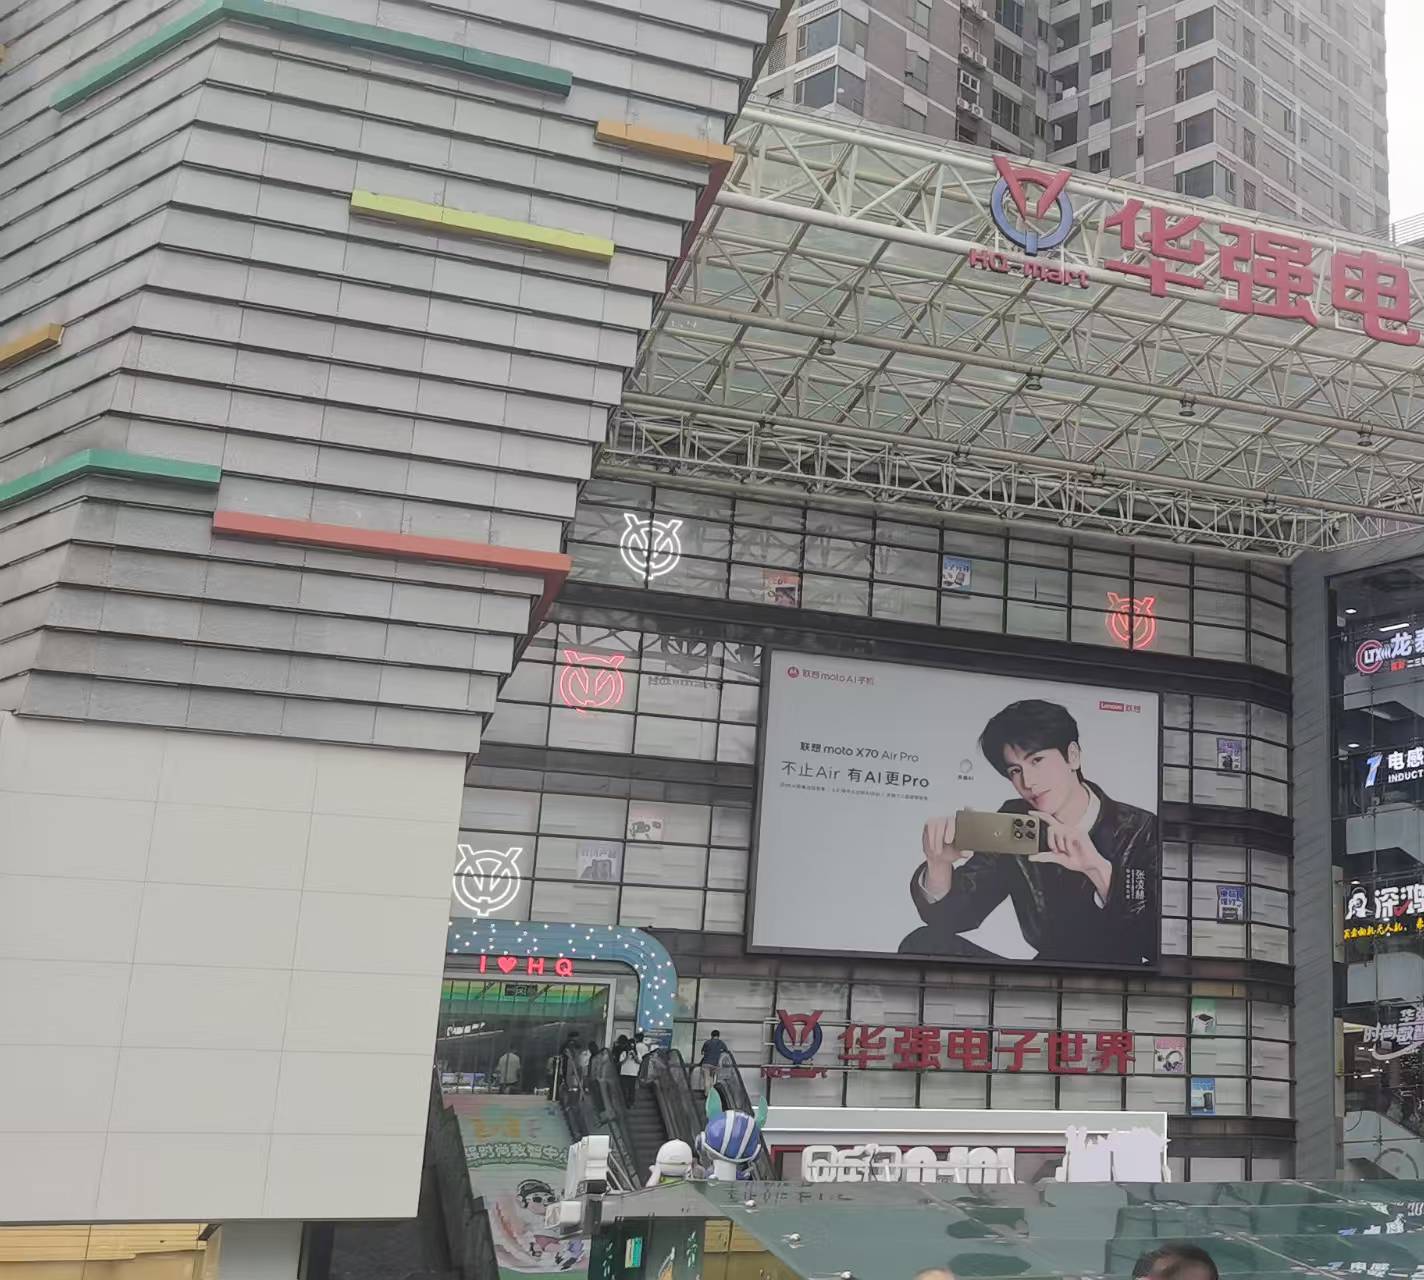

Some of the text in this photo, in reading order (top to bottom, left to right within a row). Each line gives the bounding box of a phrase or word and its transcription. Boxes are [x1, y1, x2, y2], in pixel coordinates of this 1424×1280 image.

[800, 741, 920, 763] 联想 moto X70 Air Pro
[781, 760, 930, 788] 不止Air 有AI更Pro
[838, 1023, 1136, 1075] 华强电子世界
